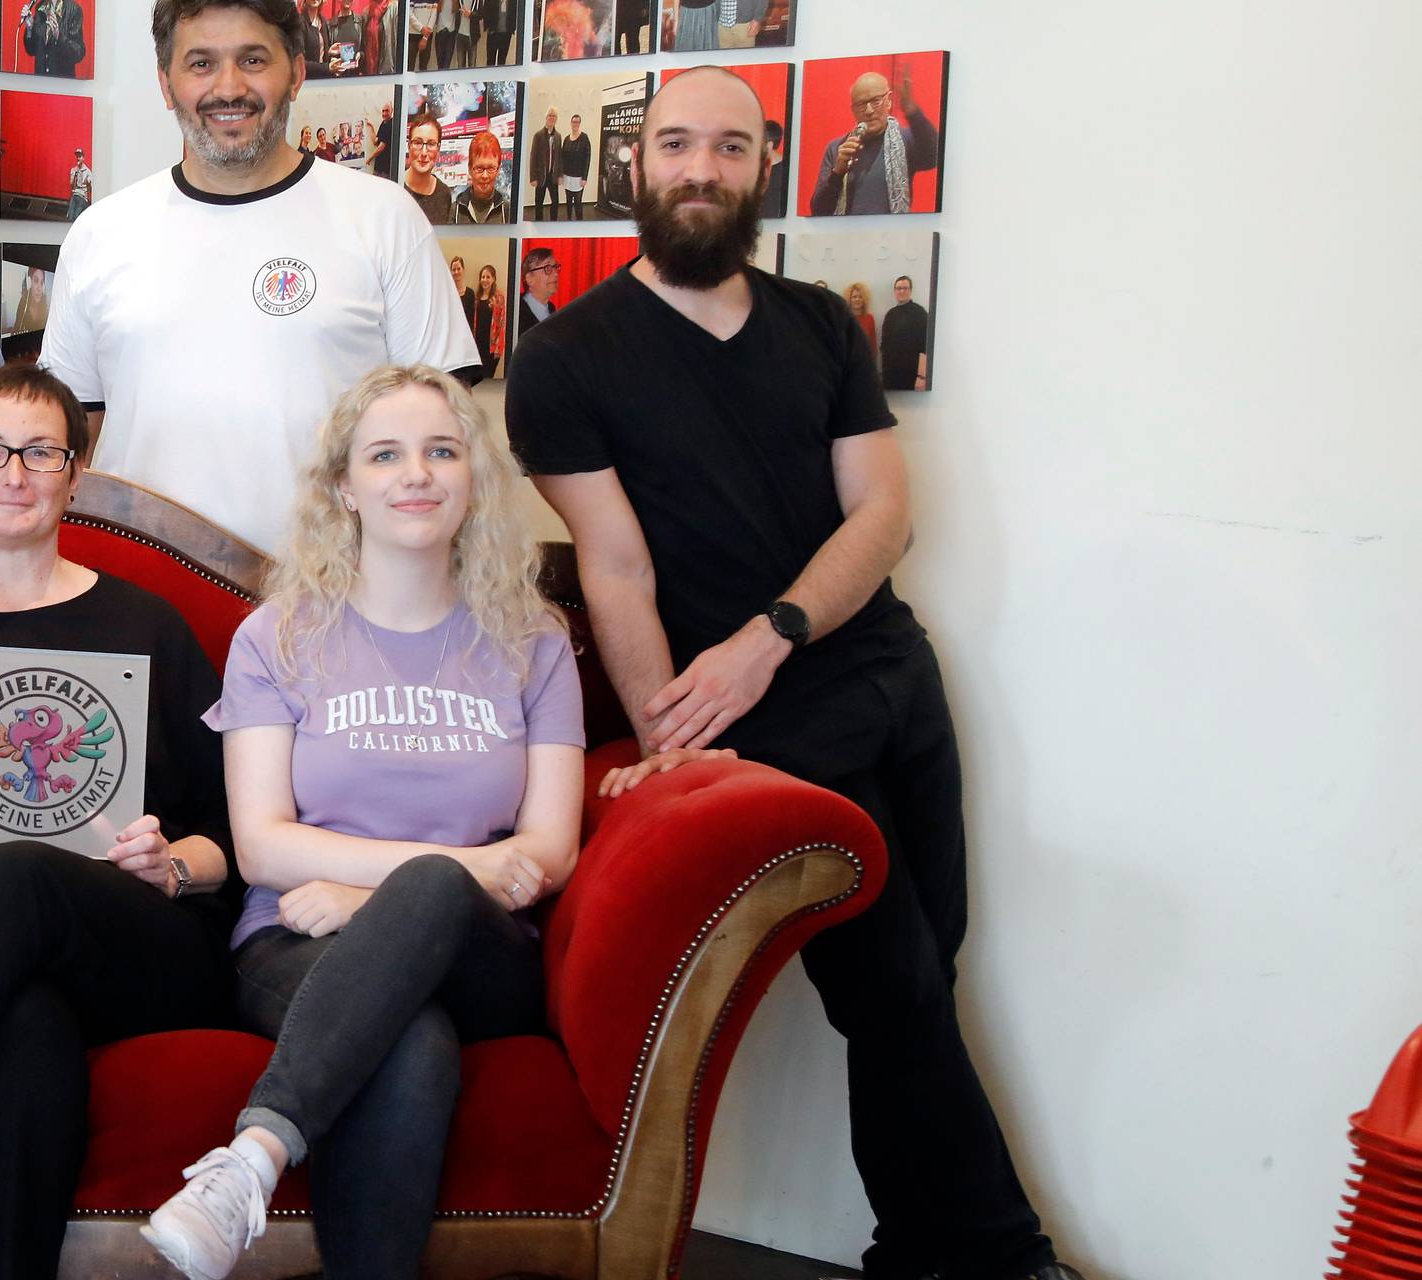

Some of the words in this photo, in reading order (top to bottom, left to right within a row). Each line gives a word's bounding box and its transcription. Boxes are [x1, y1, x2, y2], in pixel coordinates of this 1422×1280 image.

[615, 106, 644, 118] LANGE
[266, 260, 307, 272] VIELFALT
[256, 291, 264, 303] IST
[263, 302, 285, 314] MEINE
[287, 289, 312, 312] HEIMAT
[324, 685, 509, 740] HOLLISTER
[348, 731, 490, 753] CALIFORNIA
[52, 767, 115, 827] HEIMAT
